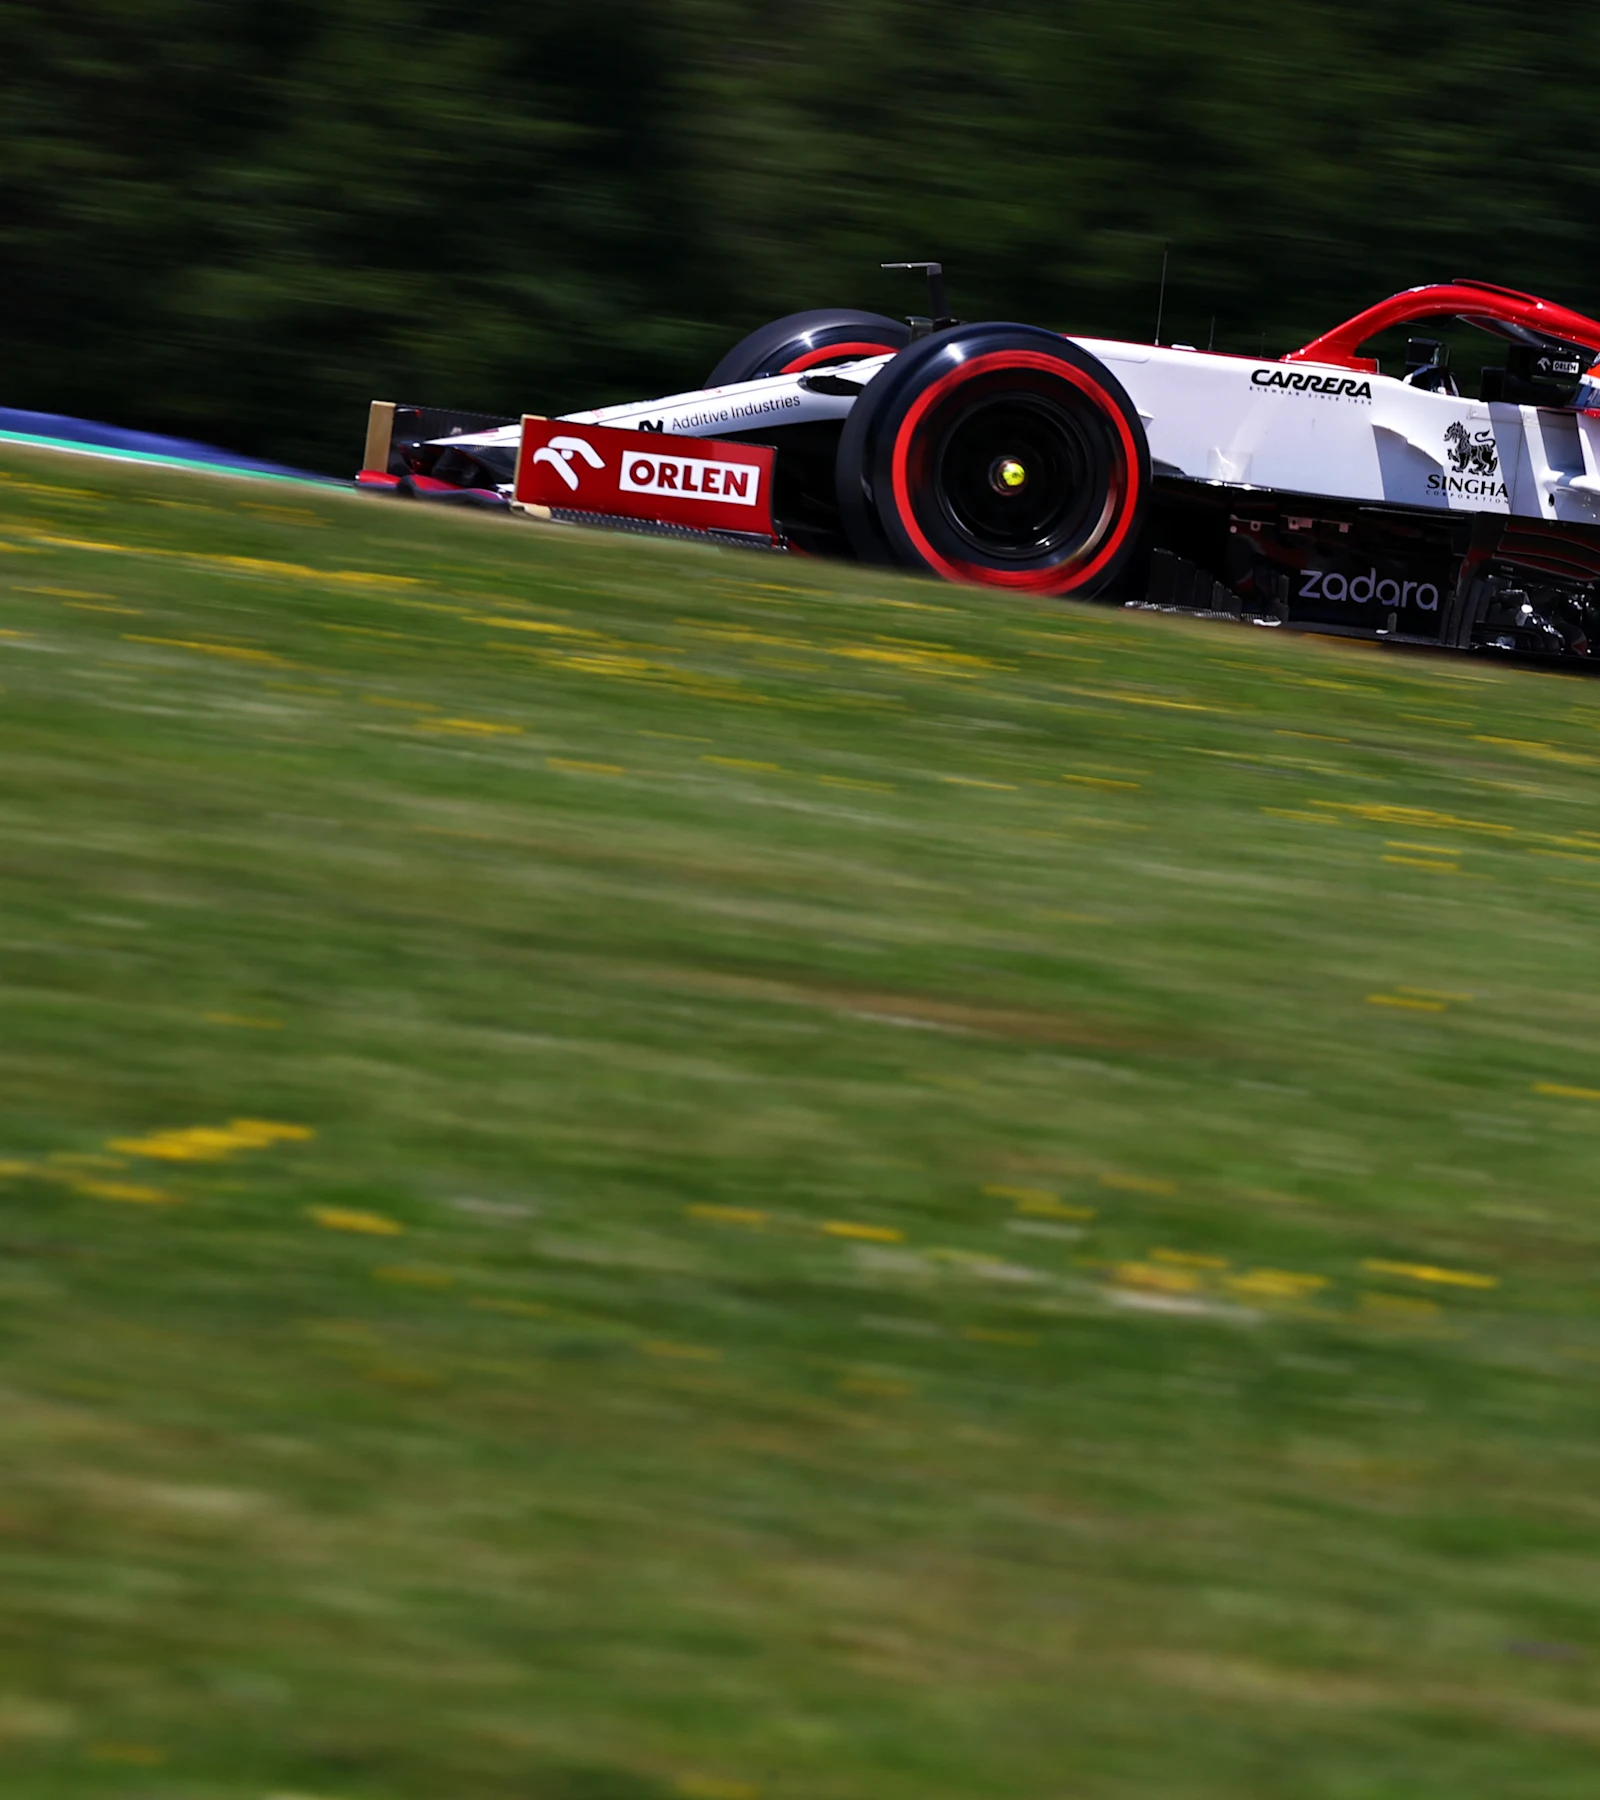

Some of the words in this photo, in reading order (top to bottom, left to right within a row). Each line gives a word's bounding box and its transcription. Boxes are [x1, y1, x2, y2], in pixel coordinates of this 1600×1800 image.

[1249, 386, 1300, 397] EYEWEAR
[1308, 393, 1339, 402] SINCE
[1250, 369, 1372, 399] CARRERA
[671, 408, 729, 431] Additive
[731, 395, 801, 419] Industries
[629, 459, 749, 497] ORLEN
[1426, 474, 1508, 498] SINGHA
[1426, 490, 1509, 504] CORPORATION
[1299, 567, 1439, 611] zadara
